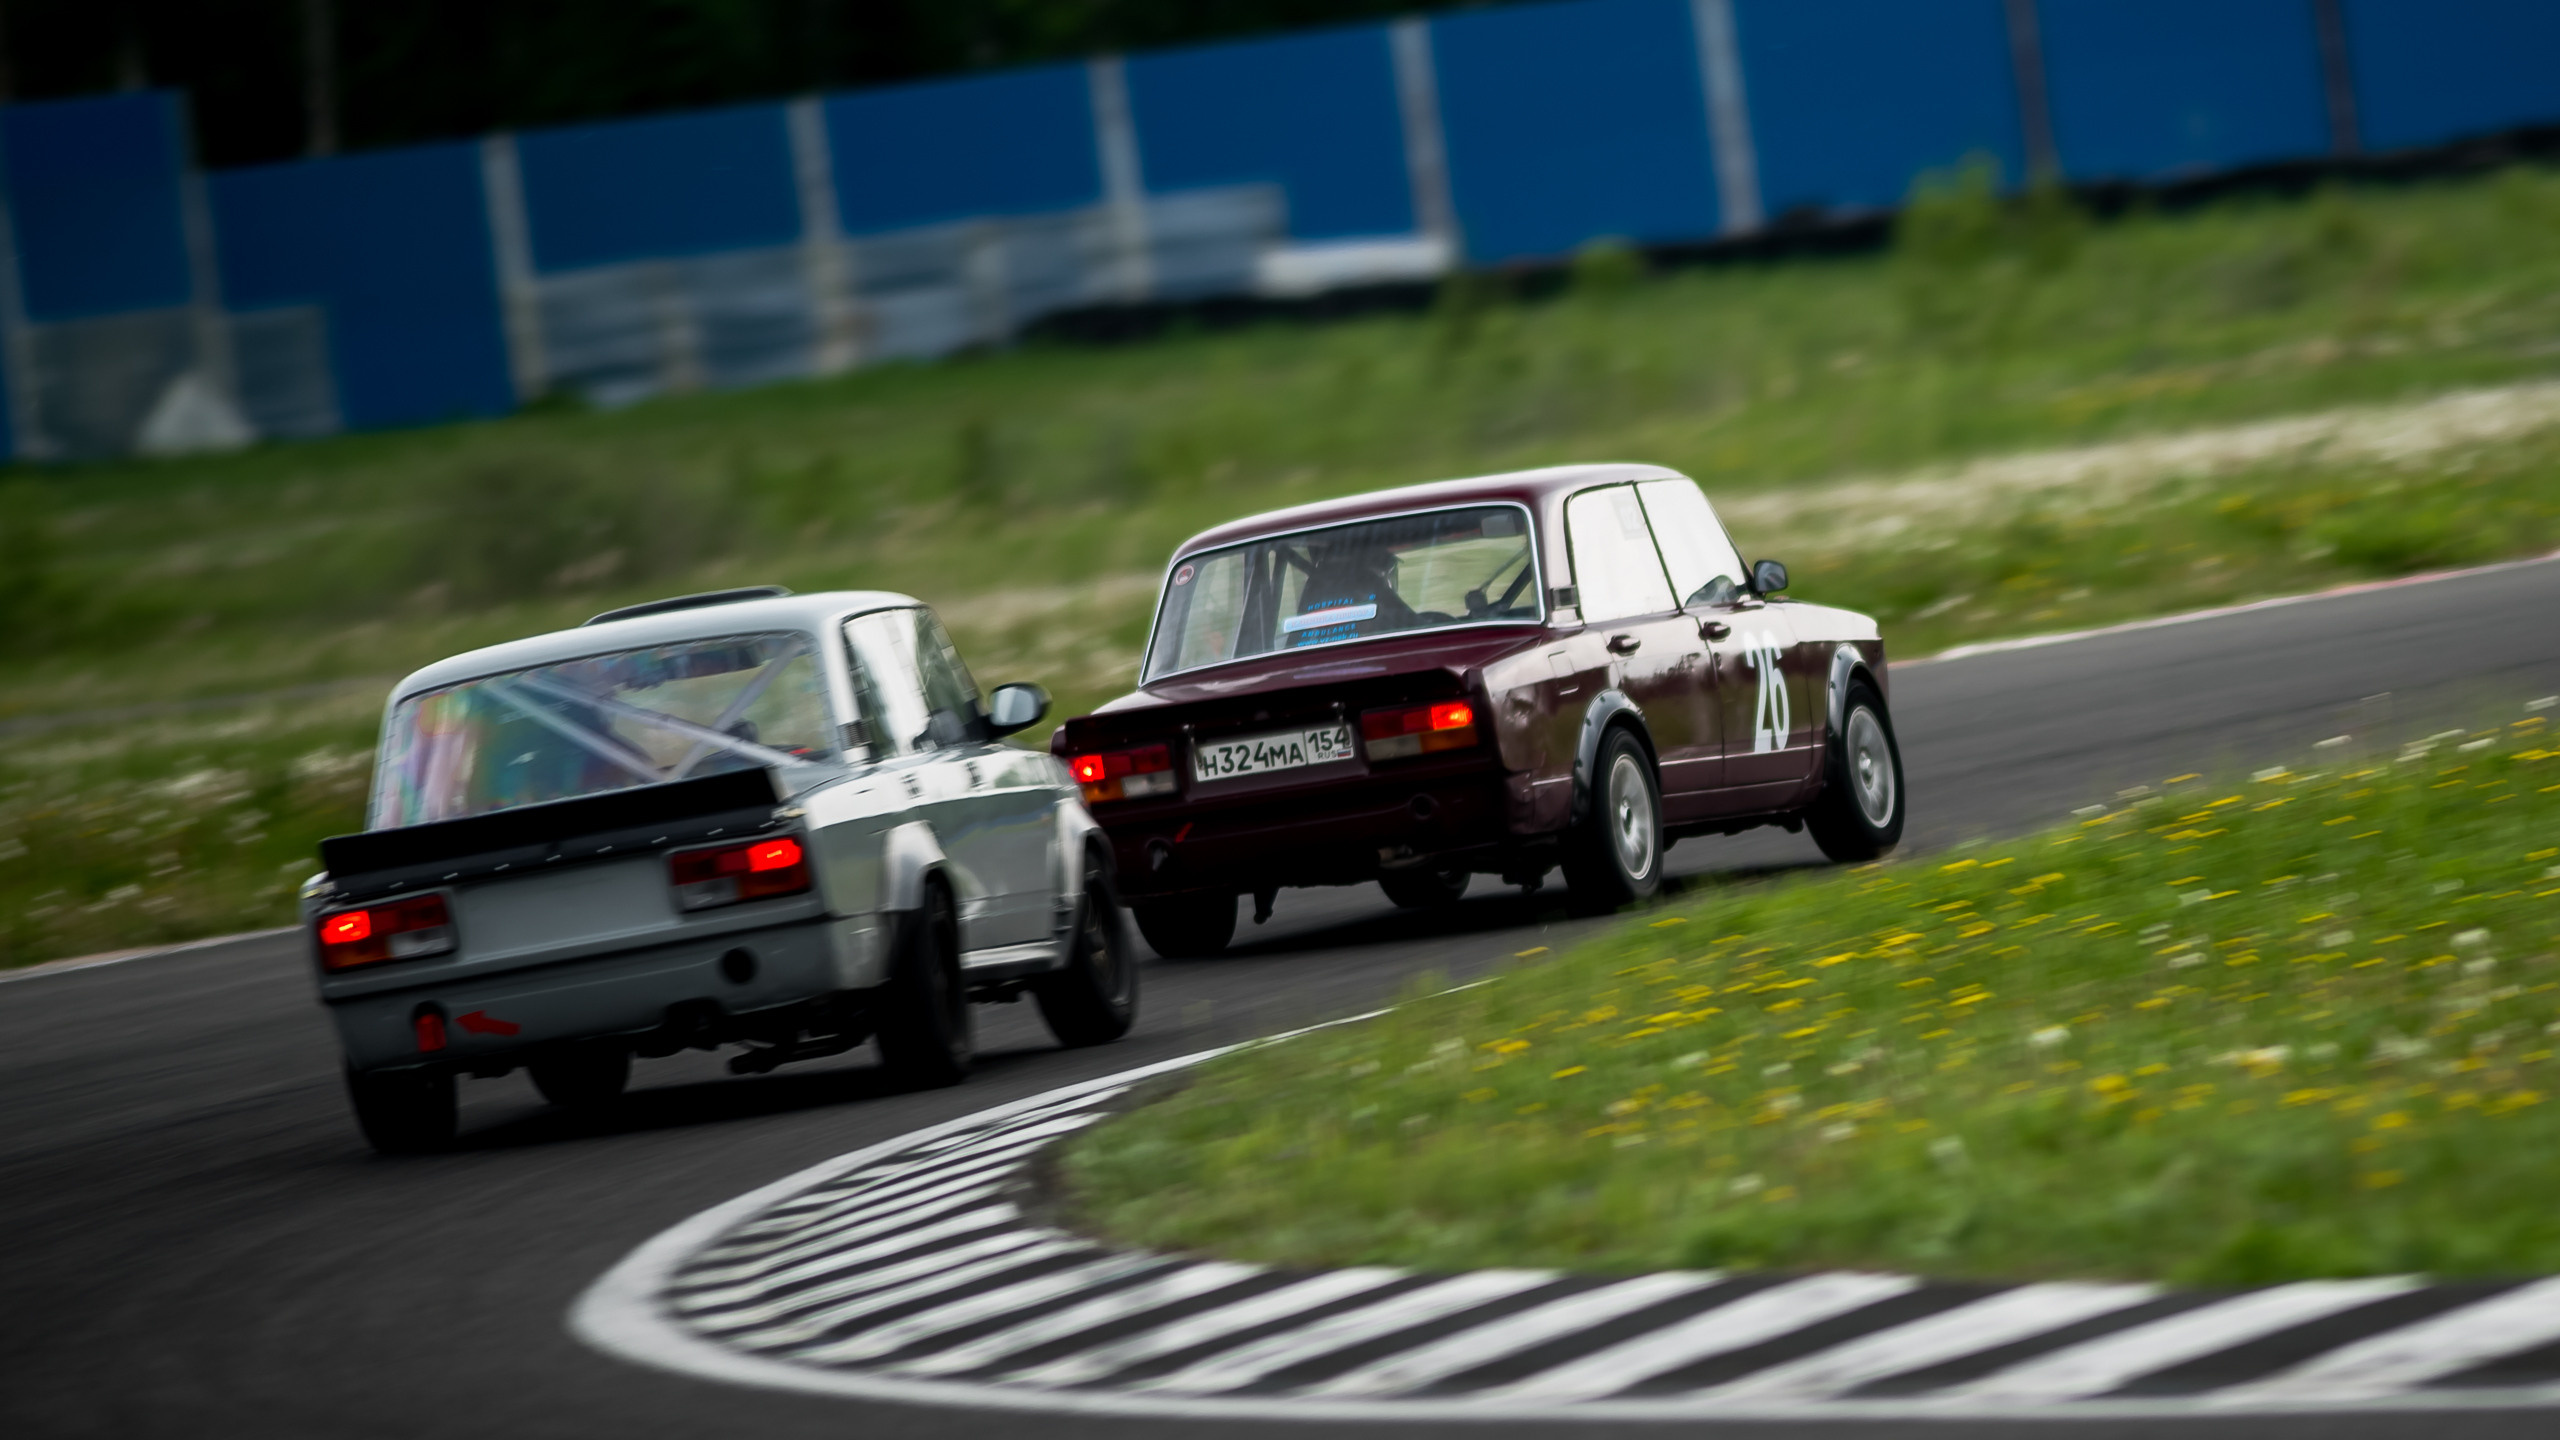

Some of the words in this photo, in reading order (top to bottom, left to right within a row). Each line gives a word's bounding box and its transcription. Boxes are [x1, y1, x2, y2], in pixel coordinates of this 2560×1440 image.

[1743, 629, 1790, 753] 26
[1307, 729, 1350, 753] 154
[1317, 751, 1337, 760] RUS
